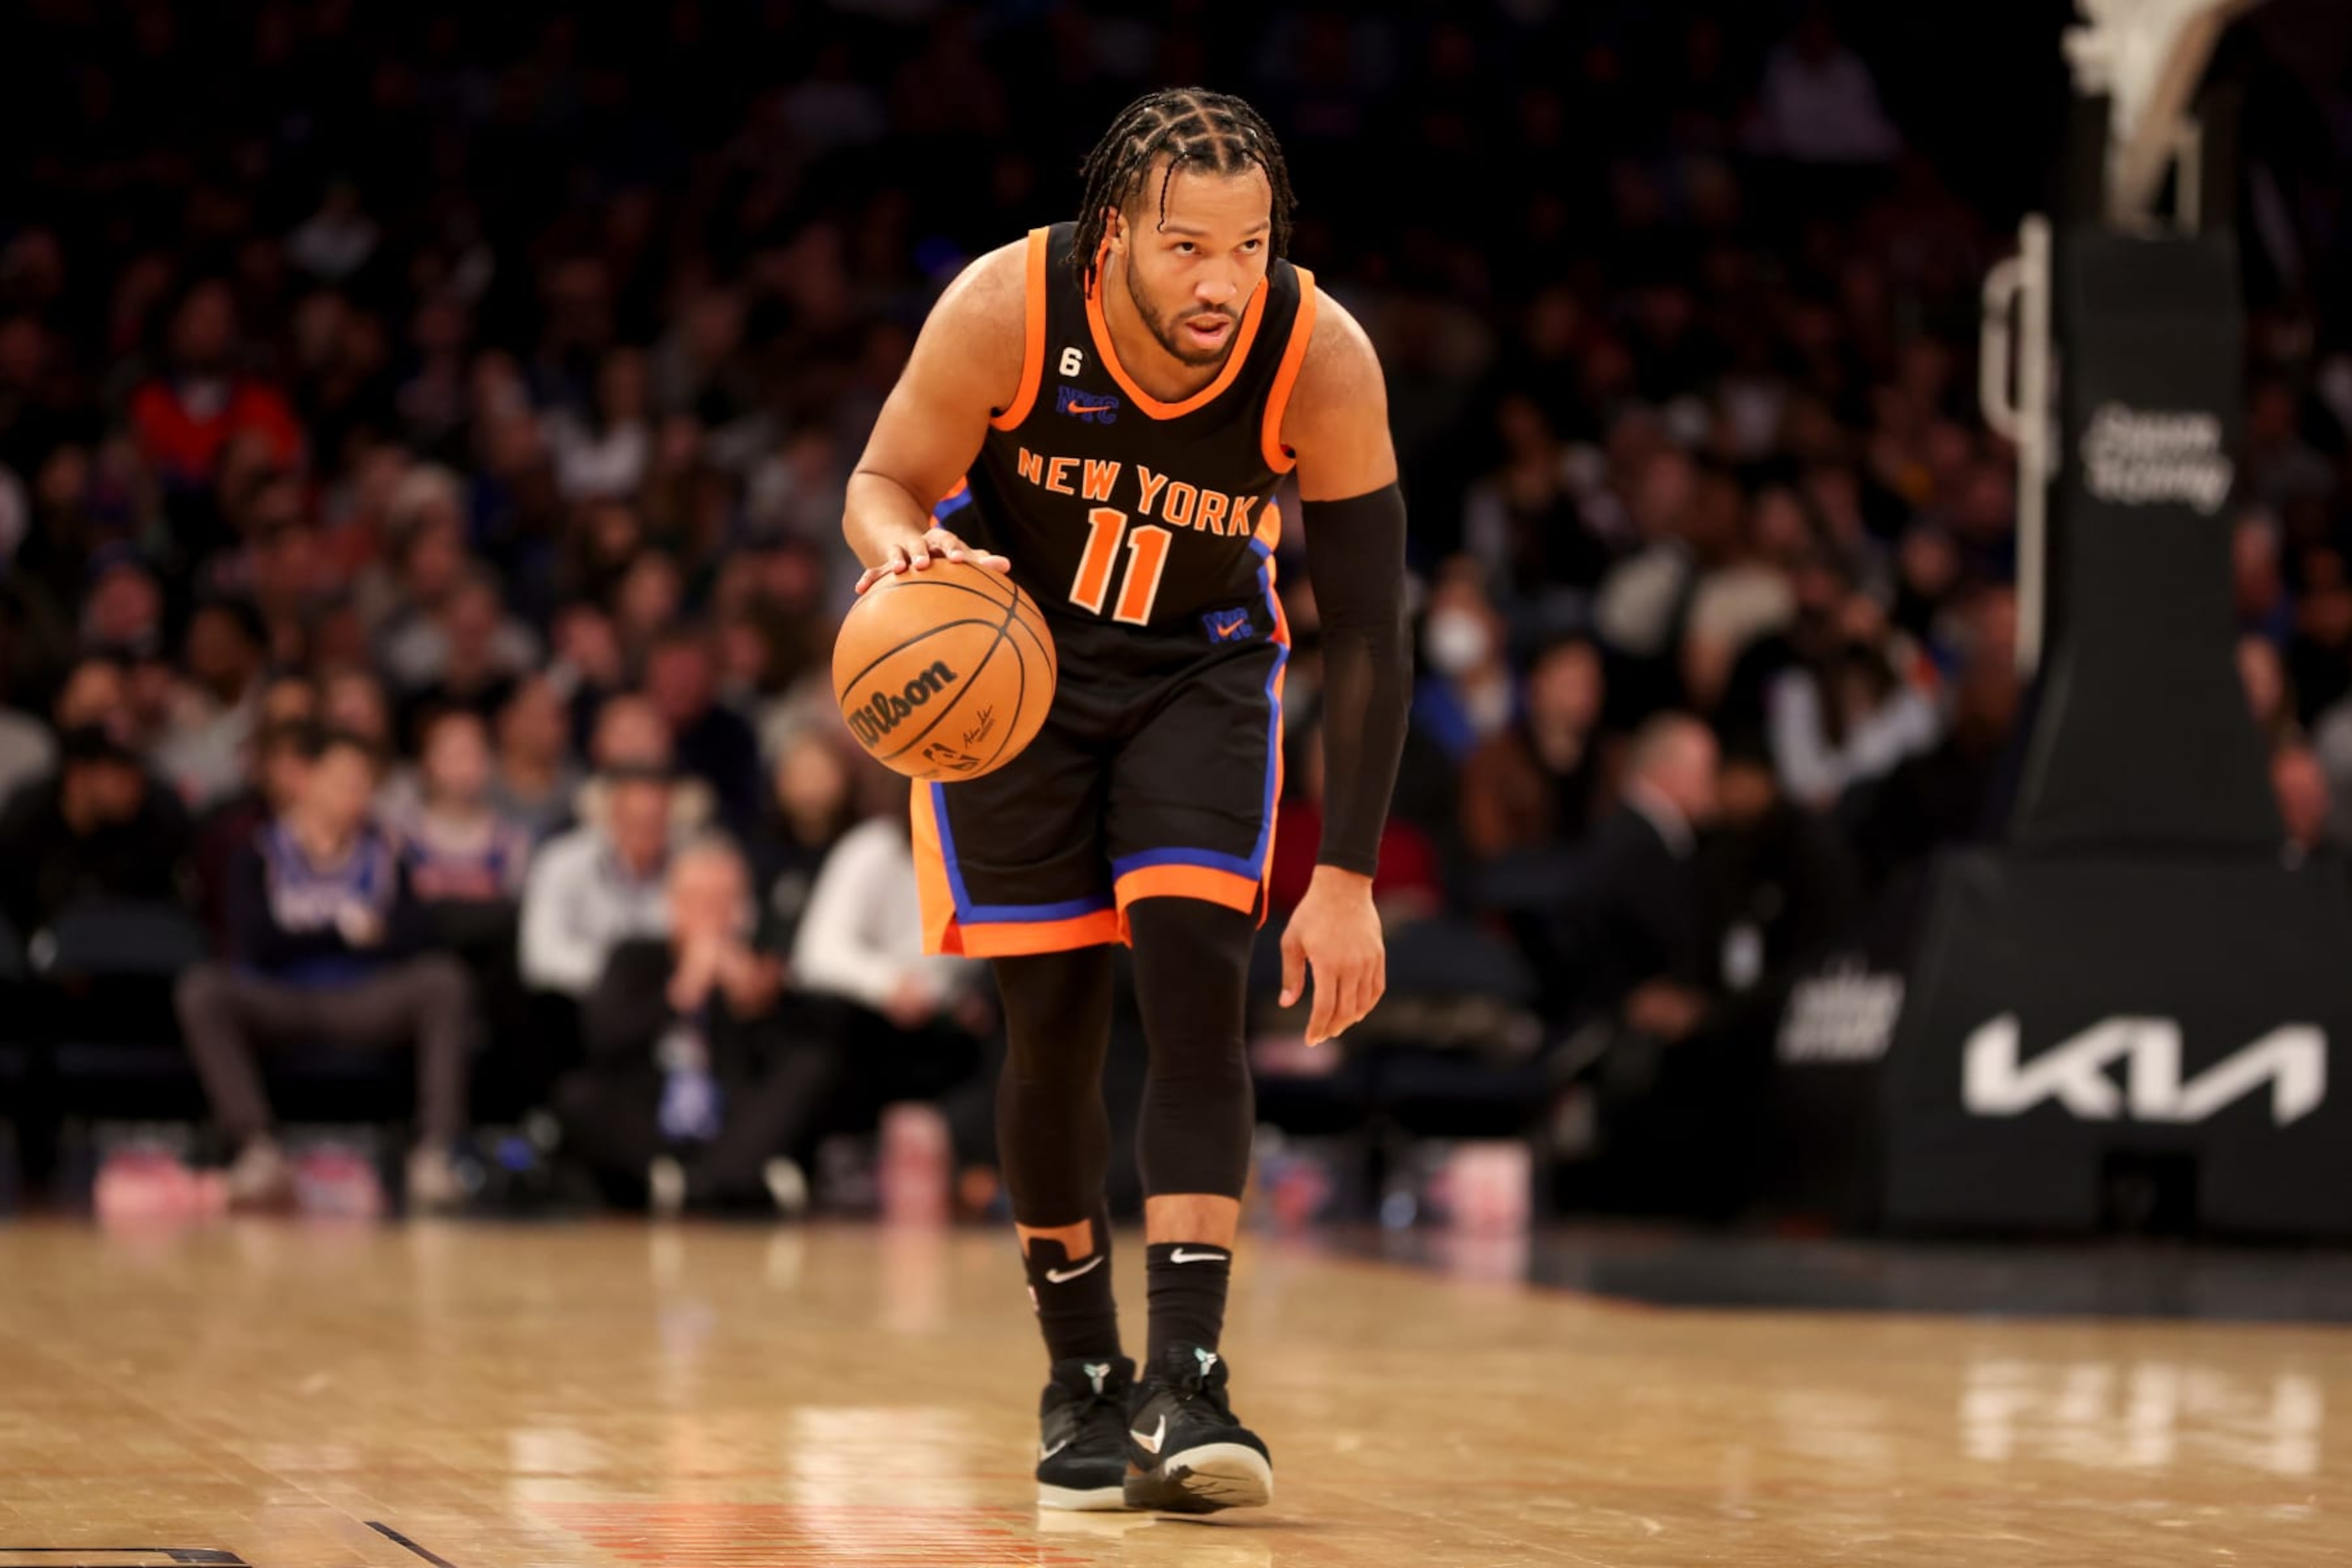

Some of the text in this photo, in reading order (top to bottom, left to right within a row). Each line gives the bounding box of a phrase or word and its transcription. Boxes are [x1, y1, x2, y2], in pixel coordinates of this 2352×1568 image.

[1059, 347, 1083, 377] 6
[1018, 447, 1259, 537] NEW YORK
[1069, 507, 1172, 626] 11
[848, 660, 958, 749] Wilson
[1962, 1013, 2327, 1128] KIA
